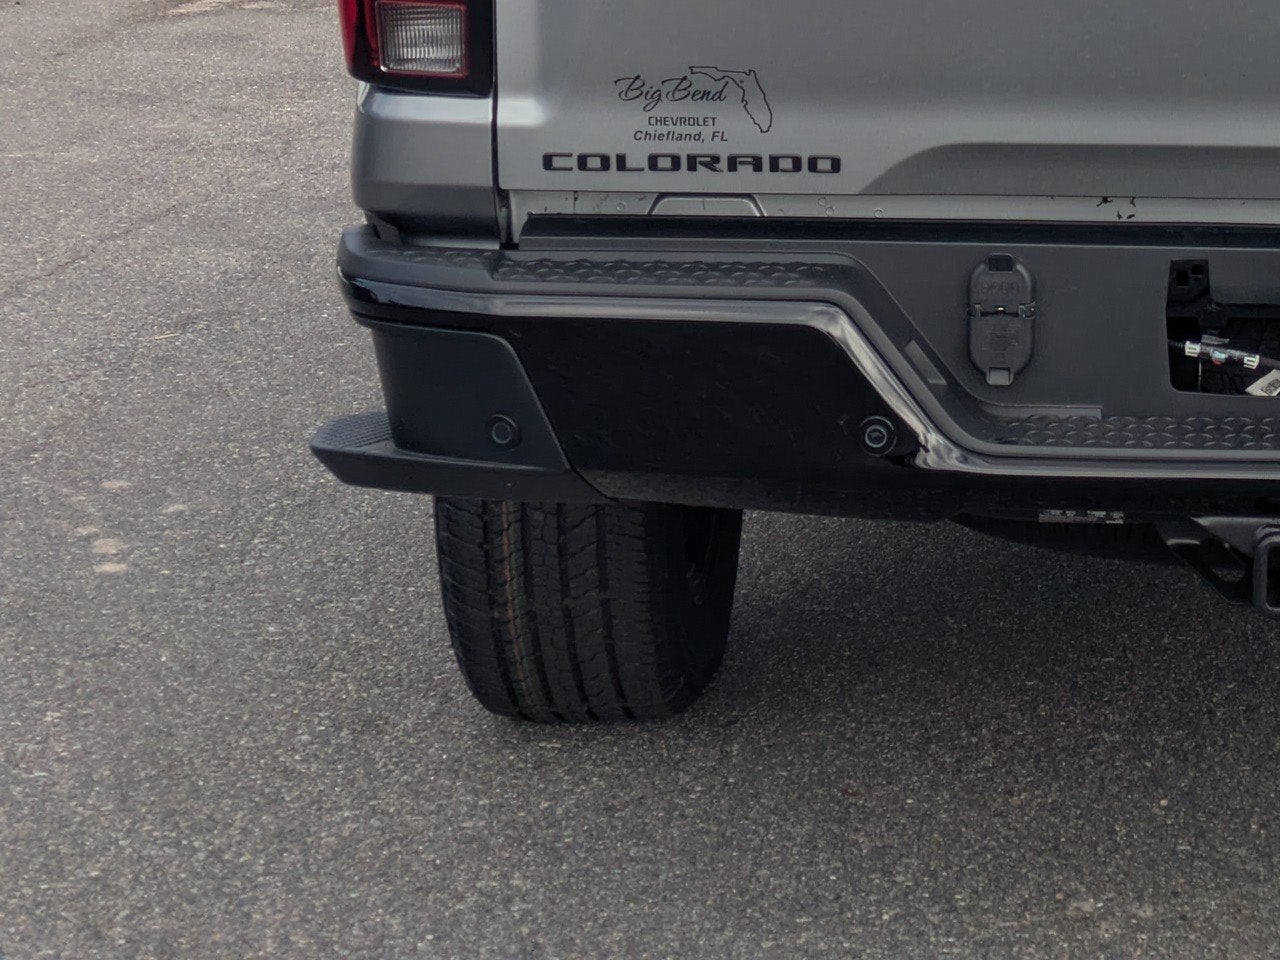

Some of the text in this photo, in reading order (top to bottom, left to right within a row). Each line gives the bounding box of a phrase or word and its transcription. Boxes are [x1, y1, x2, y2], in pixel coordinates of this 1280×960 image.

[614, 74, 729, 112] Big Bend
[647, 116, 718, 127] CHEVROLET
[633, 130, 728, 143] Chiefland, FL
[542, 152, 842, 174] COLORADO
